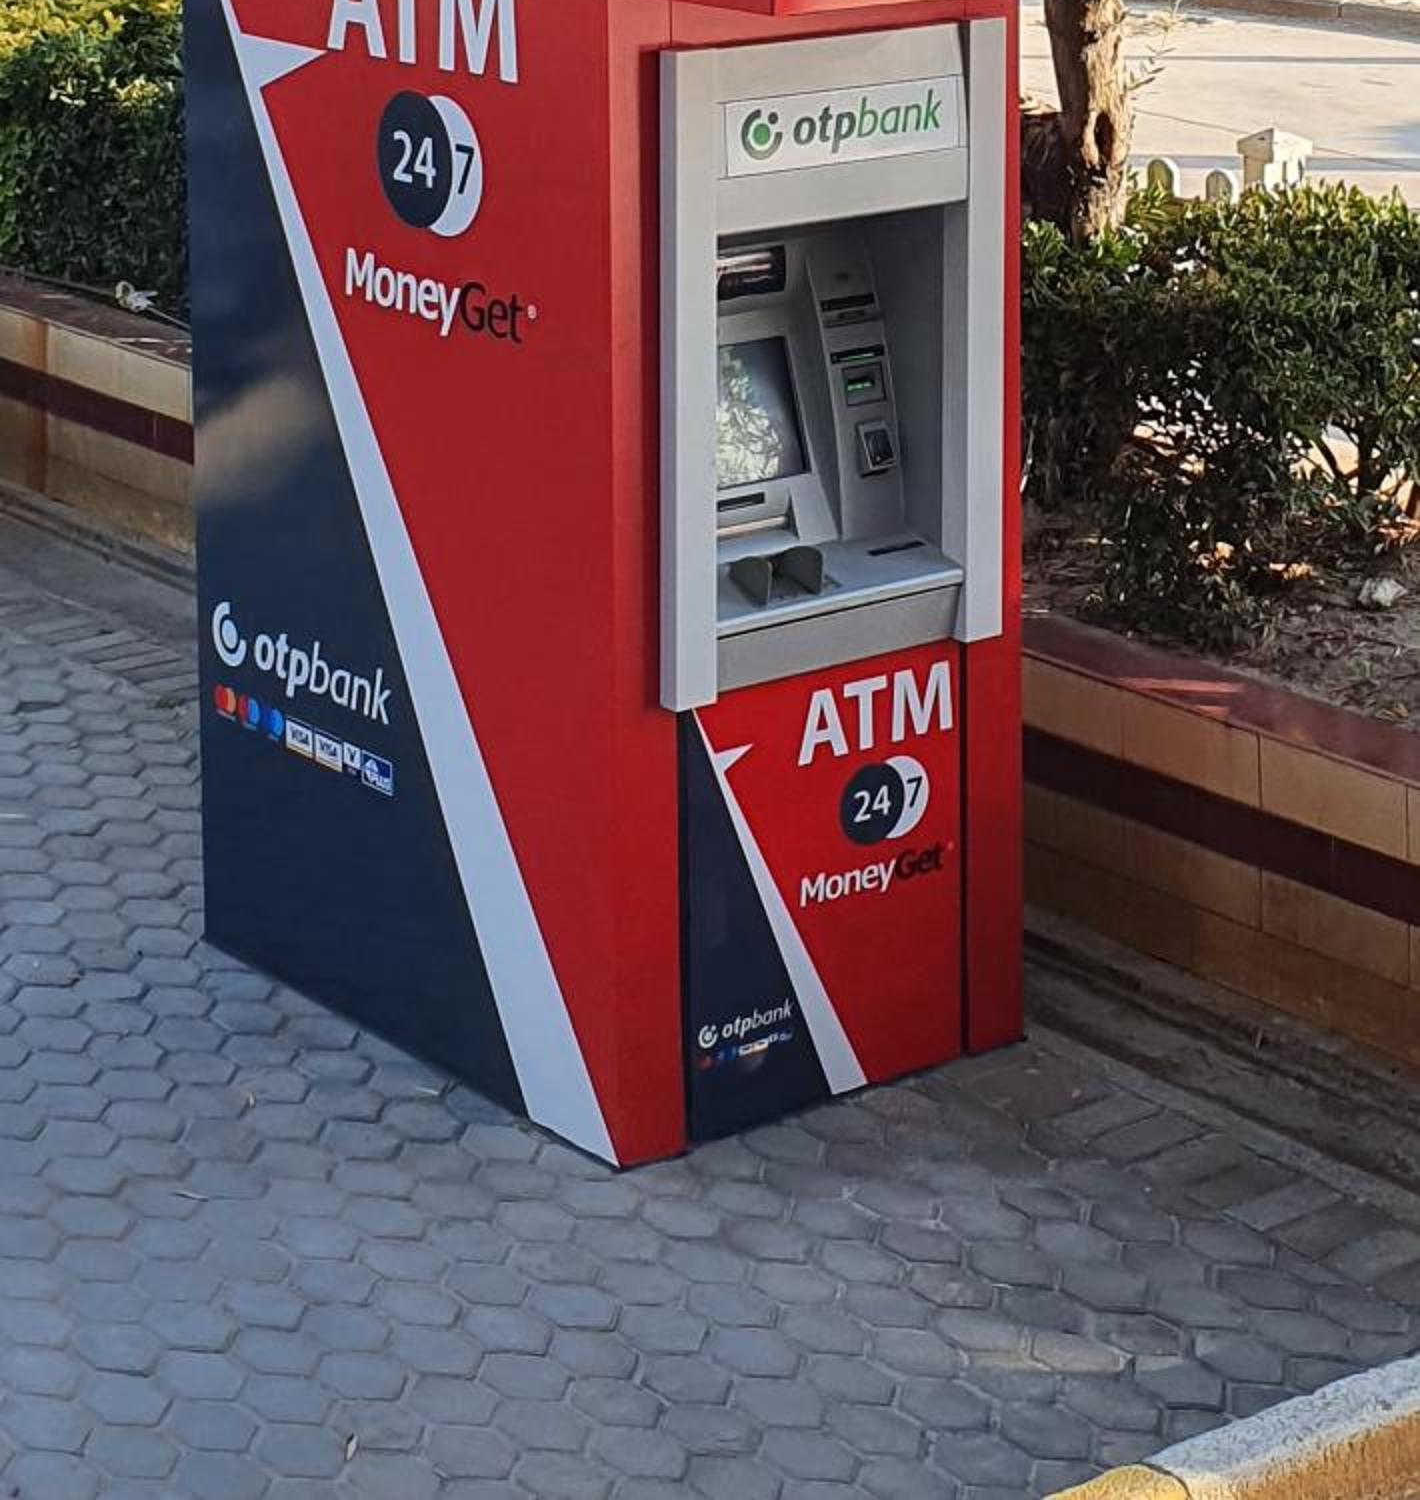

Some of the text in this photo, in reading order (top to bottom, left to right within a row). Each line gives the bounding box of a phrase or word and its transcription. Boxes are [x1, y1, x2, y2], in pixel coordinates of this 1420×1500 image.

[793, 89, 942, 153] otpbank
[392, 130, 475, 195] 24 7
[344, 247, 525, 343] MoneyGet
[254, 633, 392, 726] otpbank
[798, 660, 954, 767] ATM
[853, 775, 923, 823] 24 7
[800, 842, 944, 908] MoneyGet
[721, 997, 793, 1039] otpbank
